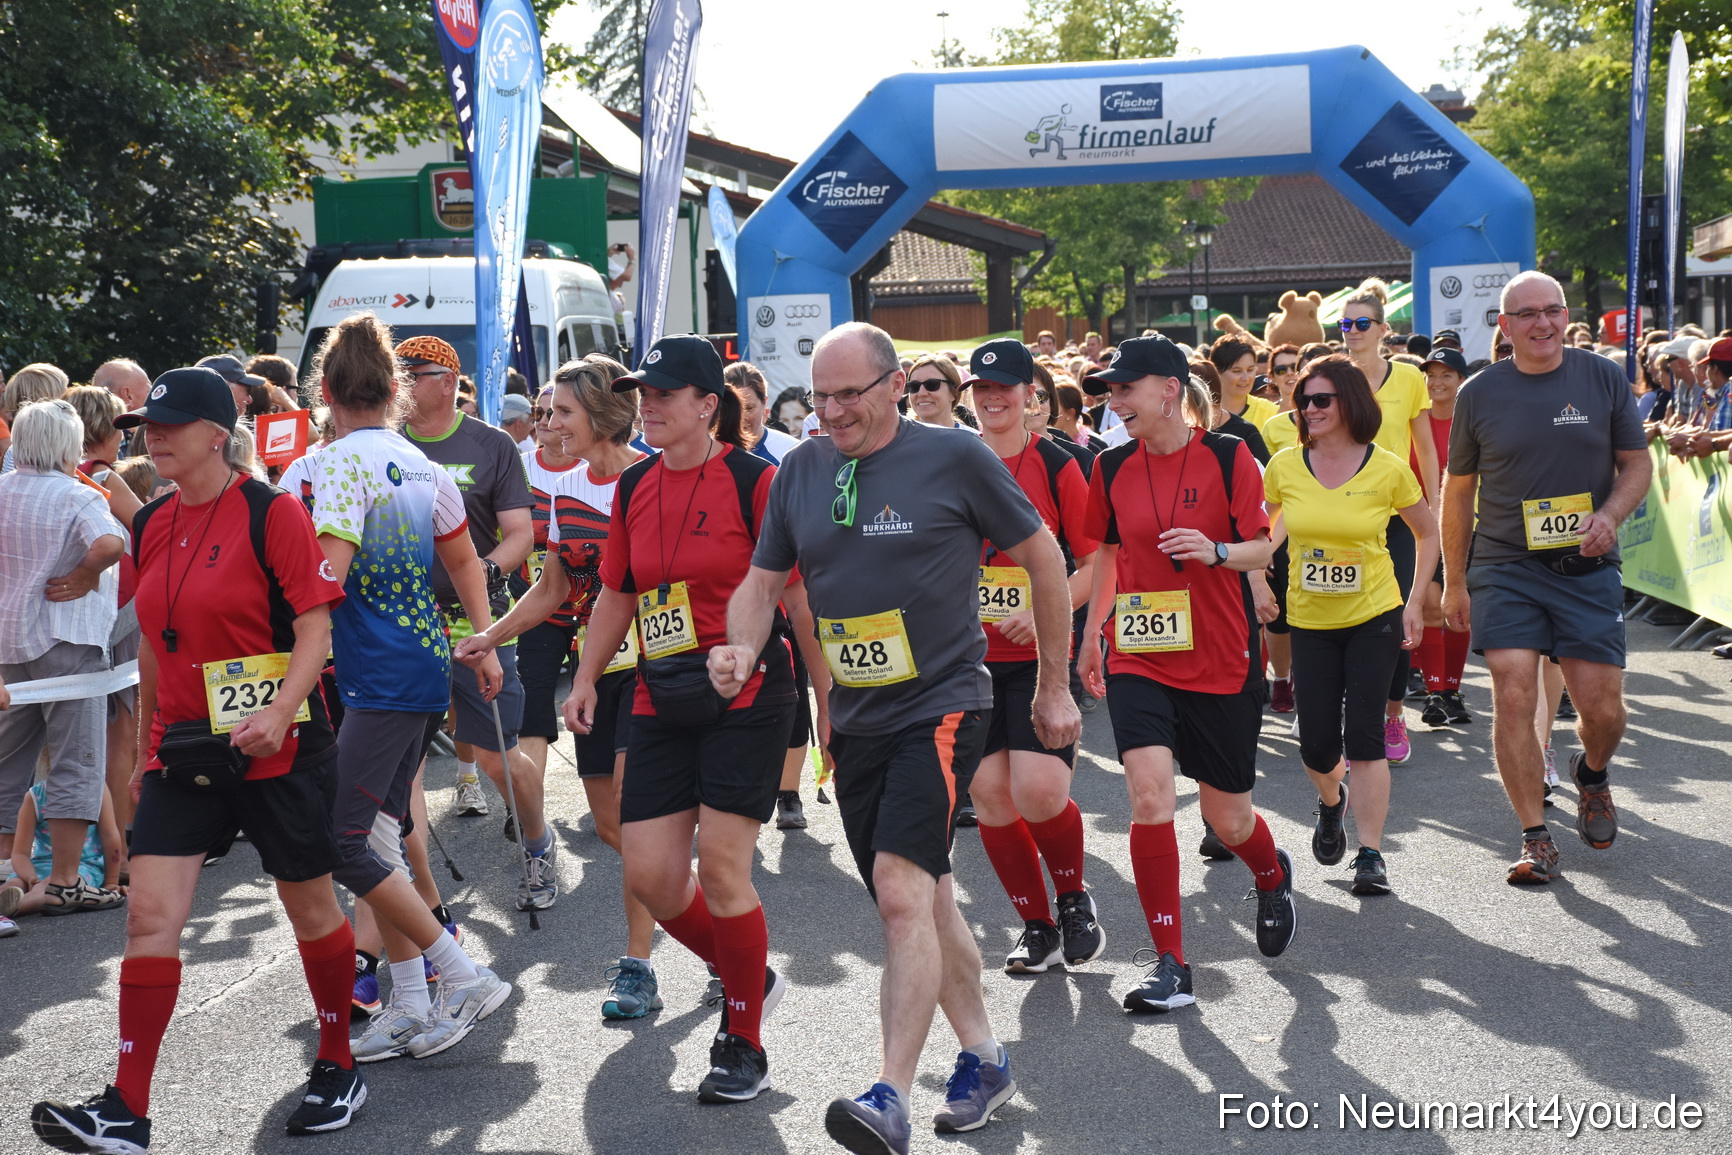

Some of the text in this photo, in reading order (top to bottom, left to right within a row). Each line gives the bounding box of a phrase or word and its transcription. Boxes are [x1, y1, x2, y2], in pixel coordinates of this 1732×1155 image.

[672, 16, 691, 126] AUTOMOBILE
[1113, 97, 1159, 108] Fischer
[1078, 117, 1217, 149] firmenlauf
[1079, 149, 1135, 159] neumarkt
[1389, 152, 1409, 163] das
[1425, 160, 1450, 170] mit!
[817, 182, 890, 198] Fischer
[824, 198, 884, 207] AUTOMOBILE
[449, 213, 471, 224] 1628
[328, 295, 387, 308] abavent
[1553, 415, 1588, 423] BURKHARDT
[401, 469, 432, 482] Bionorica
[1183, 488, 1197, 503] 11
[697, 511, 708, 529] 7
[1541, 513, 1580, 534] 402
[862, 522, 913, 532] BURKHARDT
[209, 545, 220, 561] 3
[1306, 563, 1356, 583] 2189
[643, 608, 684, 641] 2325
[1123, 612, 1178, 636] 2361
[668, 633, 685, 642] Christa
[840, 641, 888, 668] 428
[220, 669, 259, 681] firmenlauf
[868, 665, 893, 675] Roland
[219, 678, 285, 712] 232
